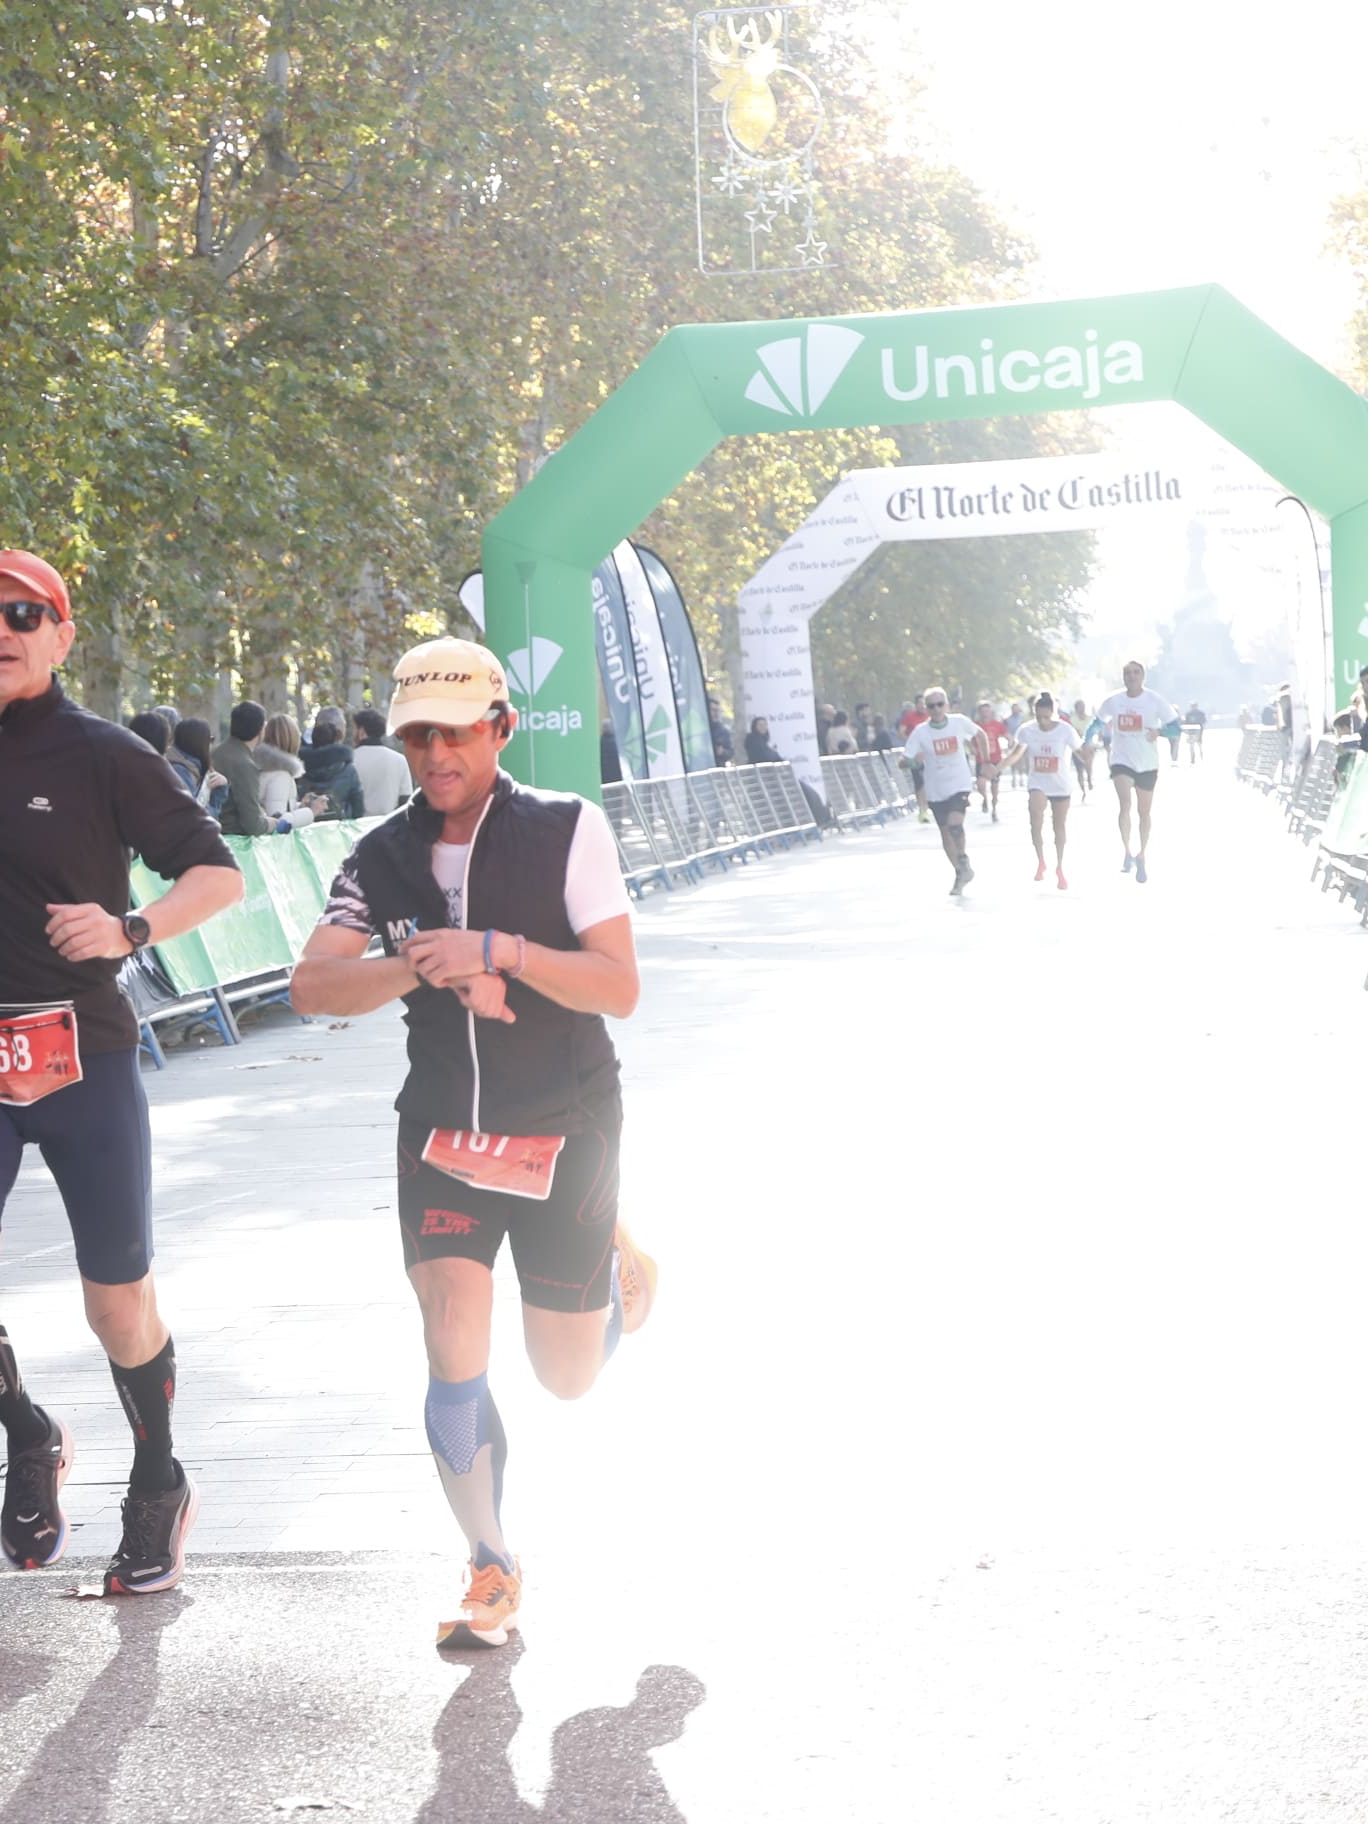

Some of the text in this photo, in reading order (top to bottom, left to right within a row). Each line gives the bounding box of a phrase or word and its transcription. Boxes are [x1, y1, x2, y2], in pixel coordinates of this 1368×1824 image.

[881, 329, 1144, 402] Unicaja
[886, 469, 1182, 522] El Norte de Castilla
[515, 704, 583, 736] icaja
